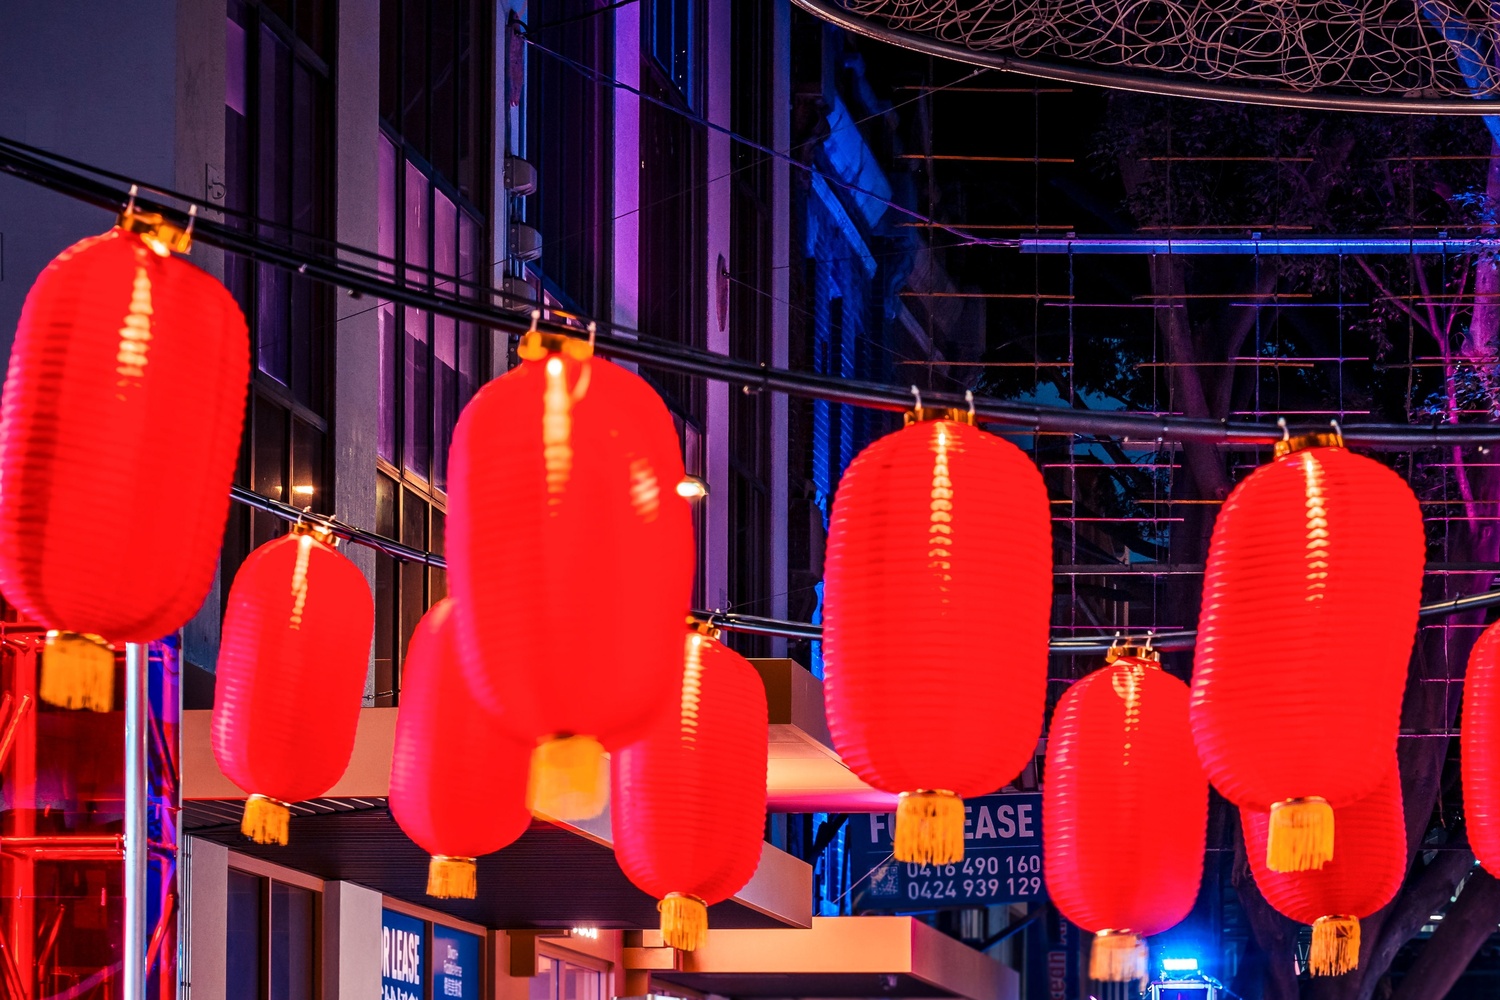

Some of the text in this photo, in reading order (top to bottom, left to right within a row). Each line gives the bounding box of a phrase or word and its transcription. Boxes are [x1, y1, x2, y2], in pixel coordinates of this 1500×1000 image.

[964, 804, 1034, 840] EASE
[962, 857, 999, 876] 490
[1006, 855, 1041, 874] 160
[908, 877, 1041, 900] 0424 939 129
[391, 928, 420, 985] LEASE
